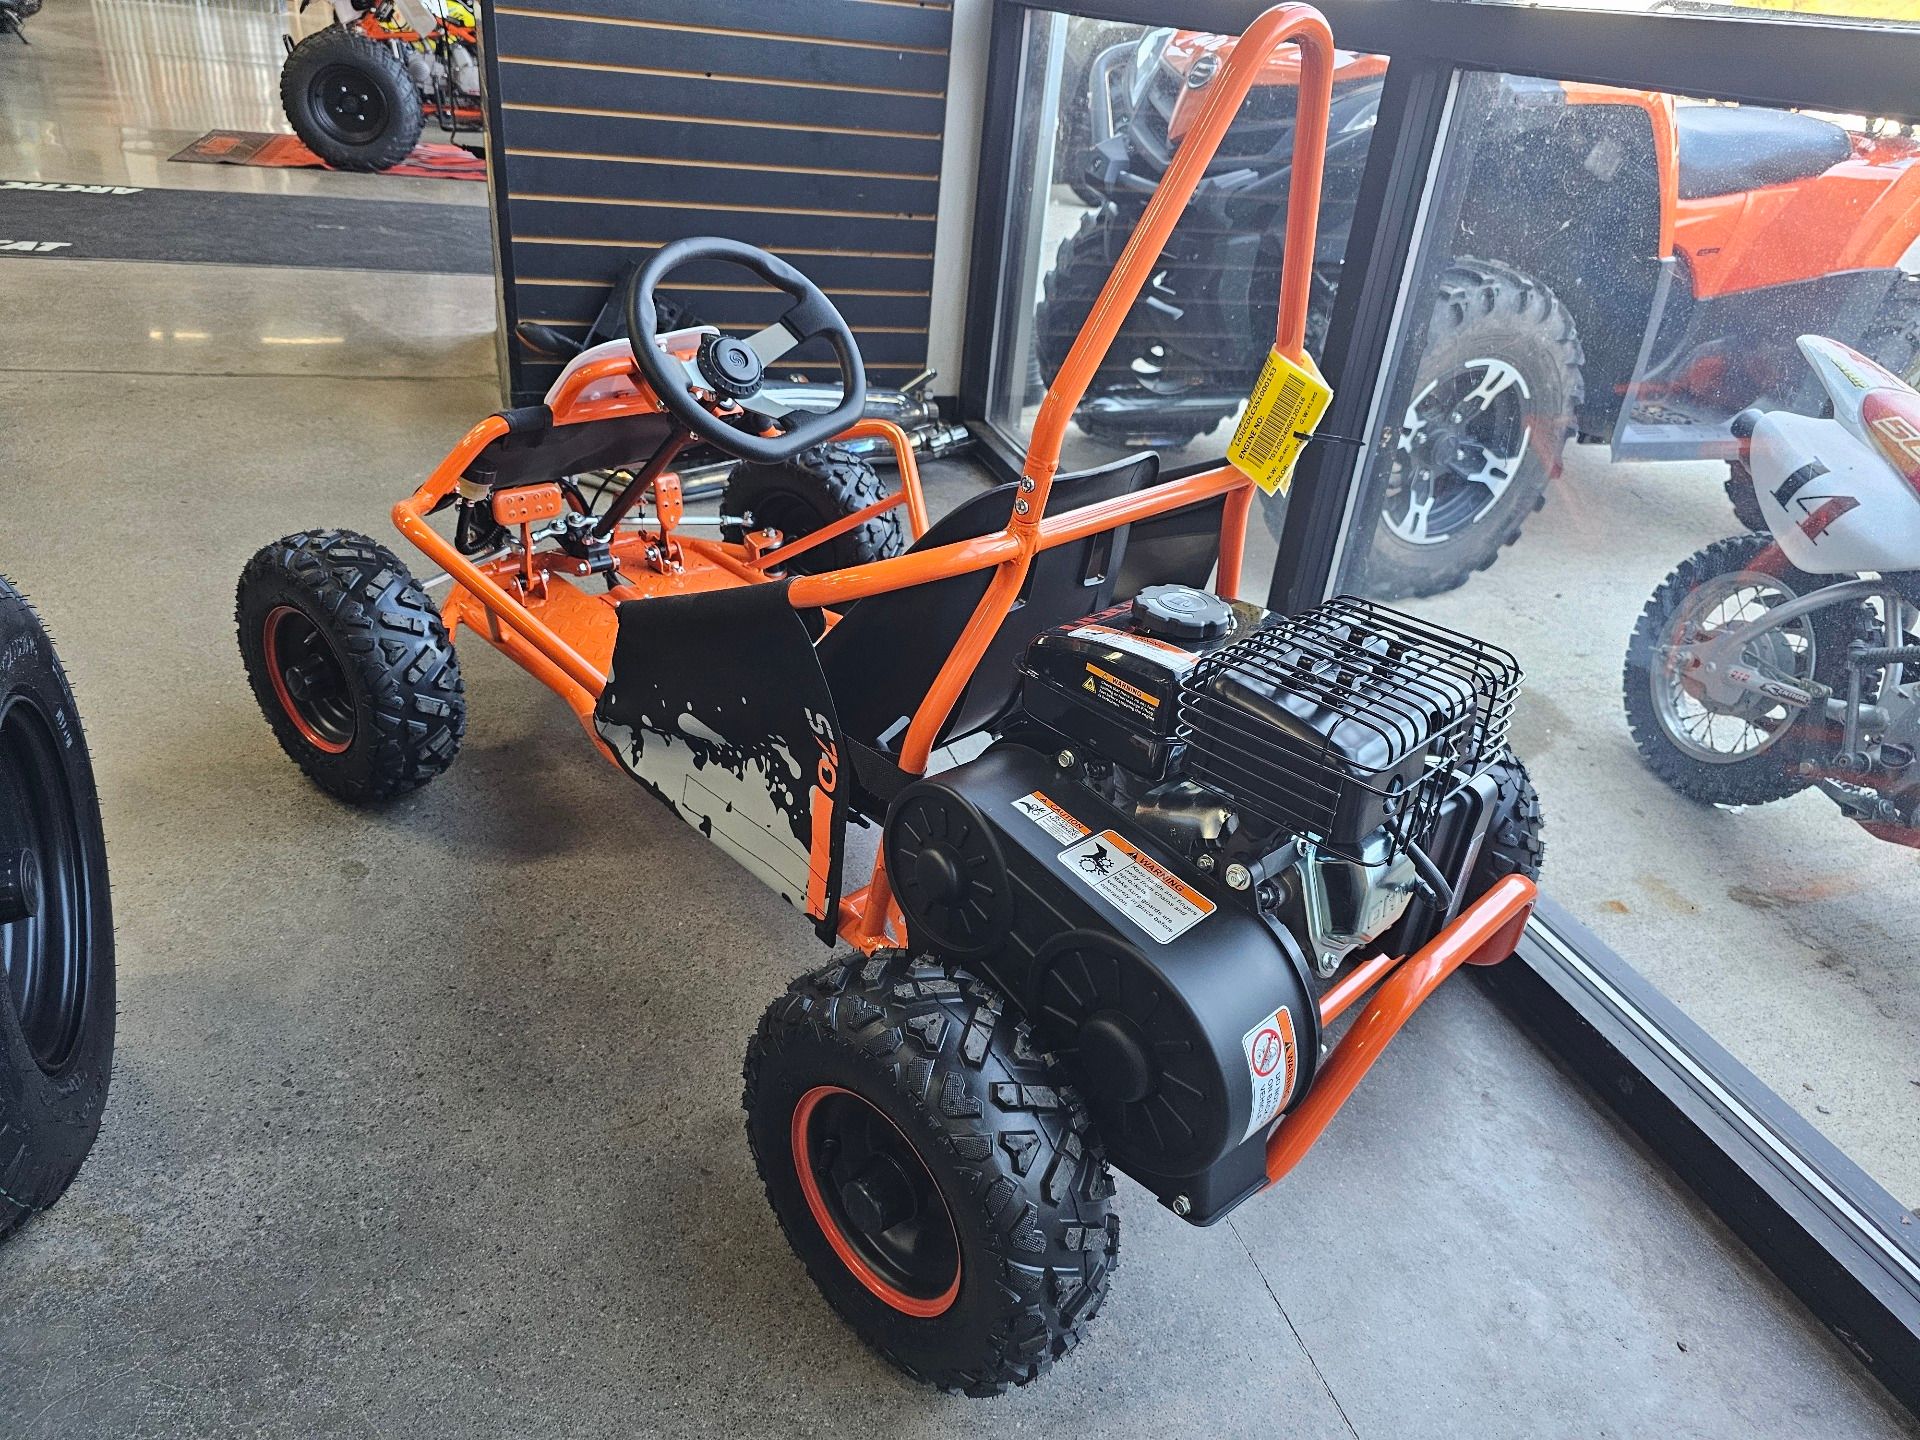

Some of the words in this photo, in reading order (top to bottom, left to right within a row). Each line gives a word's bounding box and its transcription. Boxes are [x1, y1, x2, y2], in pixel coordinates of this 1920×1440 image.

[1238, 429, 1256, 460] ENGINE
[1253, 413, 1264, 429] NO:
[1769, 455, 1862, 547] 14
[1112, 677, 1141, 697] WARNING
[1049, 804, 1083, 828] CAUTION
[1111, 875, 1129, 888] Make
[1127, 887, 1142, 899] sure
[1140, 898, 1163, 916] guards
[1123, 868, 1141, 881] away
[1139, 879, 1155, 891] from
[1153, 890, 1175, 907] chains
[1173, 905, 1187, 916] and
[1129, 864, 1148, 878] Keep
[1145, 876, 1166, 891] hands
[1163, 889, 1177, 899] and
[1174, 898, 1199, 916] fingers
[1137, 857, 1185, 892] WARNING
[1105, 879, 1132, 899] securely
[1135, 903, 1155, 918] place
[1152, 916, 1175, 933] before
